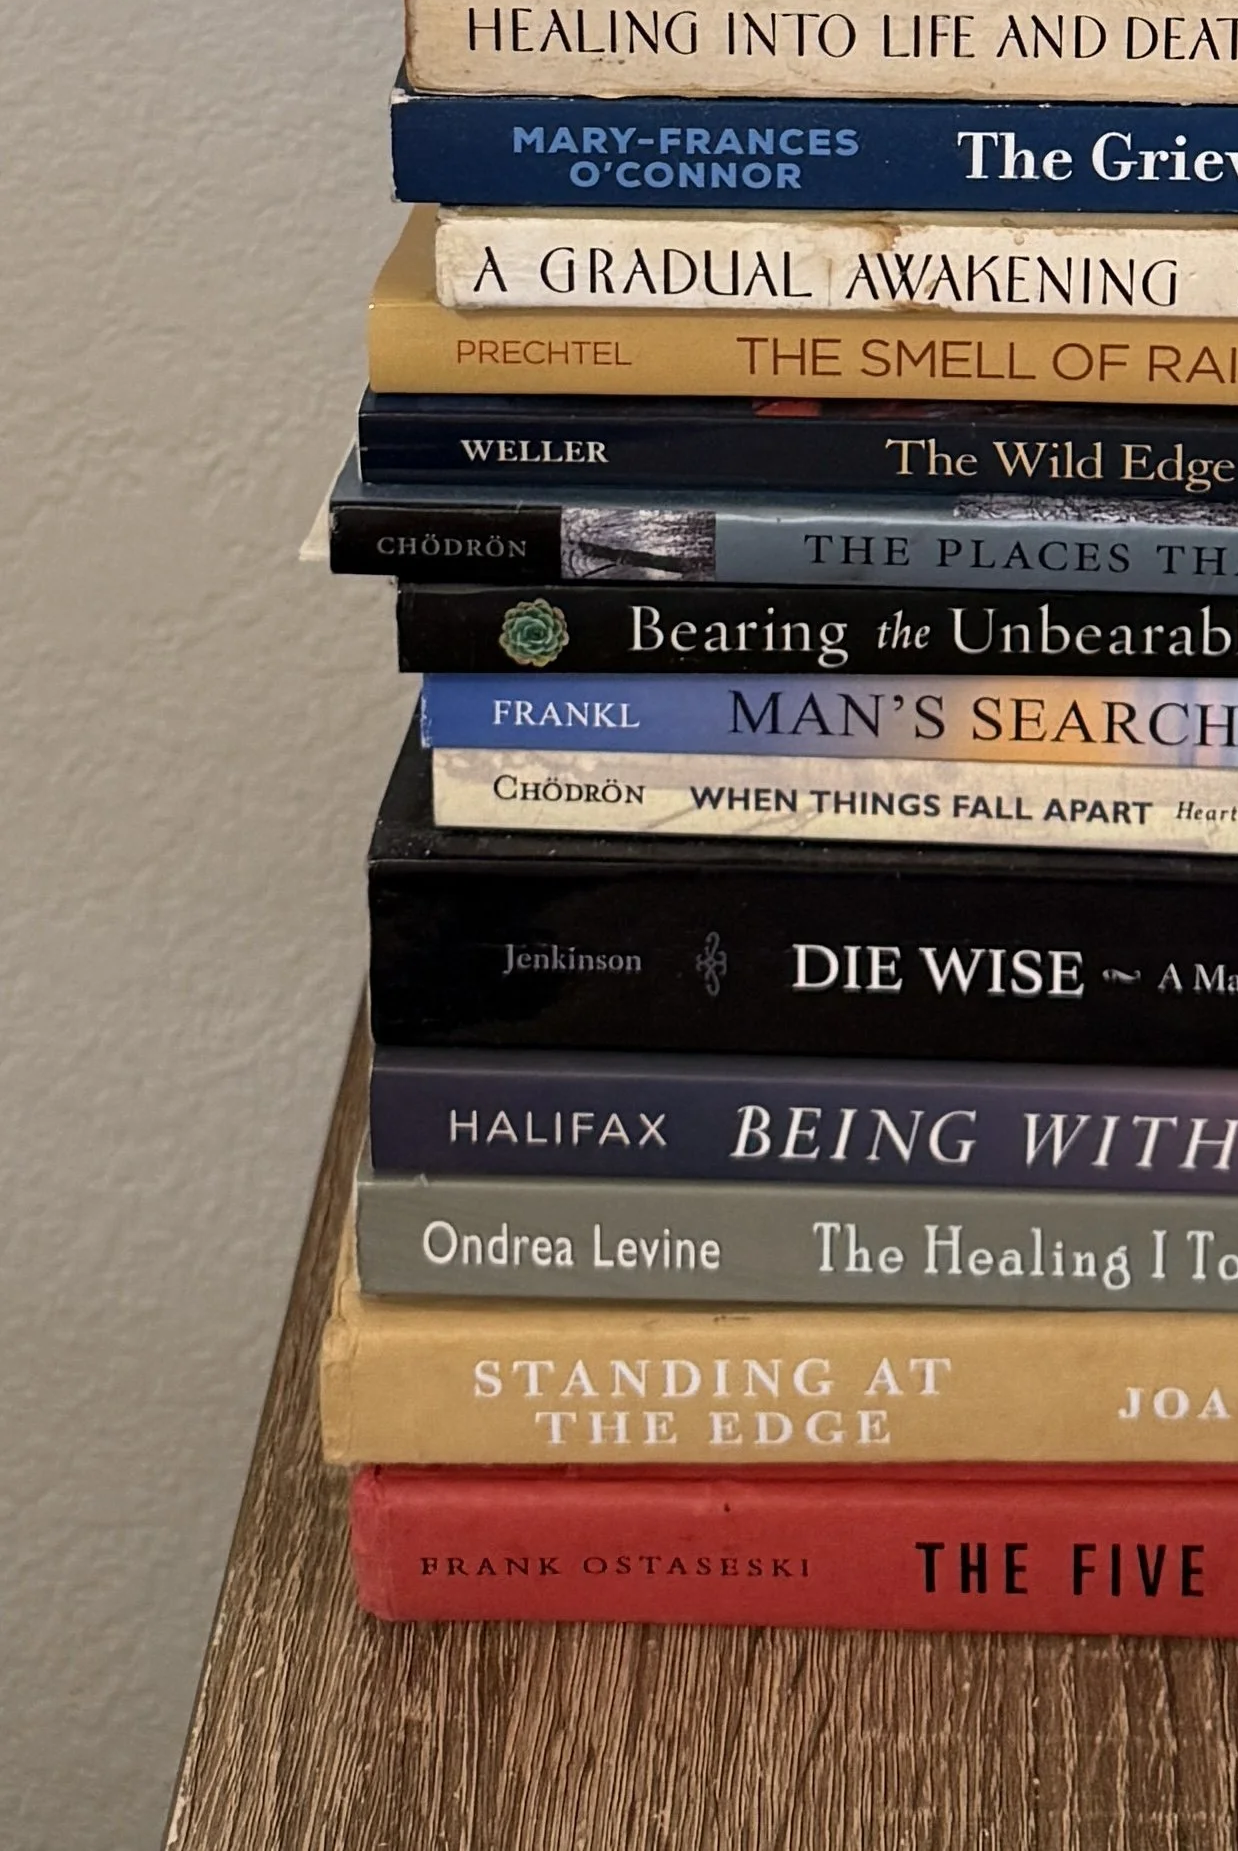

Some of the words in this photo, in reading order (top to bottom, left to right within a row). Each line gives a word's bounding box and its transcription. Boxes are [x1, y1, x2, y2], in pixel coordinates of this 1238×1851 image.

[512, 126, 859, 157] MARY-FRANCES
[958, 132, 1073, 181] The
[569, 161, 802, 189] O'CONNOR
[461, 440, 610, 464] WELLER
[886, 438, 977, 477] The
[993, 438, 1102, 480] Wild
[1120, 443, 1235, 492] Edge
[376, 534, 528, 559] CHÖDRÖN
[630, 605, 848, 666] Bearing
[876, 618, 930, 652] the
[492, 700, 641, 729] FRANKL
[690, 785, 797, 813] WHEN
[809, 790, 941, 818] THINGS
[952, 794, 1032, 820] FALL
[1044, 797, 1154, 825] APART
[1175, 801, 1237, 822] Heart
[791, 945, 903, 991] DIE
[919, 948, 1084, 997] WISE
[1158, 965, 1182, 992] A
[450, 1110, 668, 1147] HALIFAX
[422, 1220, 573, 1268] Ondrea
[594, 1224, 720, 1270] Levine
[474, 1359, 832, 1397] STANDING
[865, 1357, 953, 1396] AT
[535, 1412, 678, 1445] THE
[709, 1410, 892, 1444] EDGE
[421, 1556, 562, 1575] FRANK
[583, 1556, 811, 1577] OSTASESKI
[915, 1542, 1028, 1594] THE
[1073, 1544, 1204, 1596] FIVE
